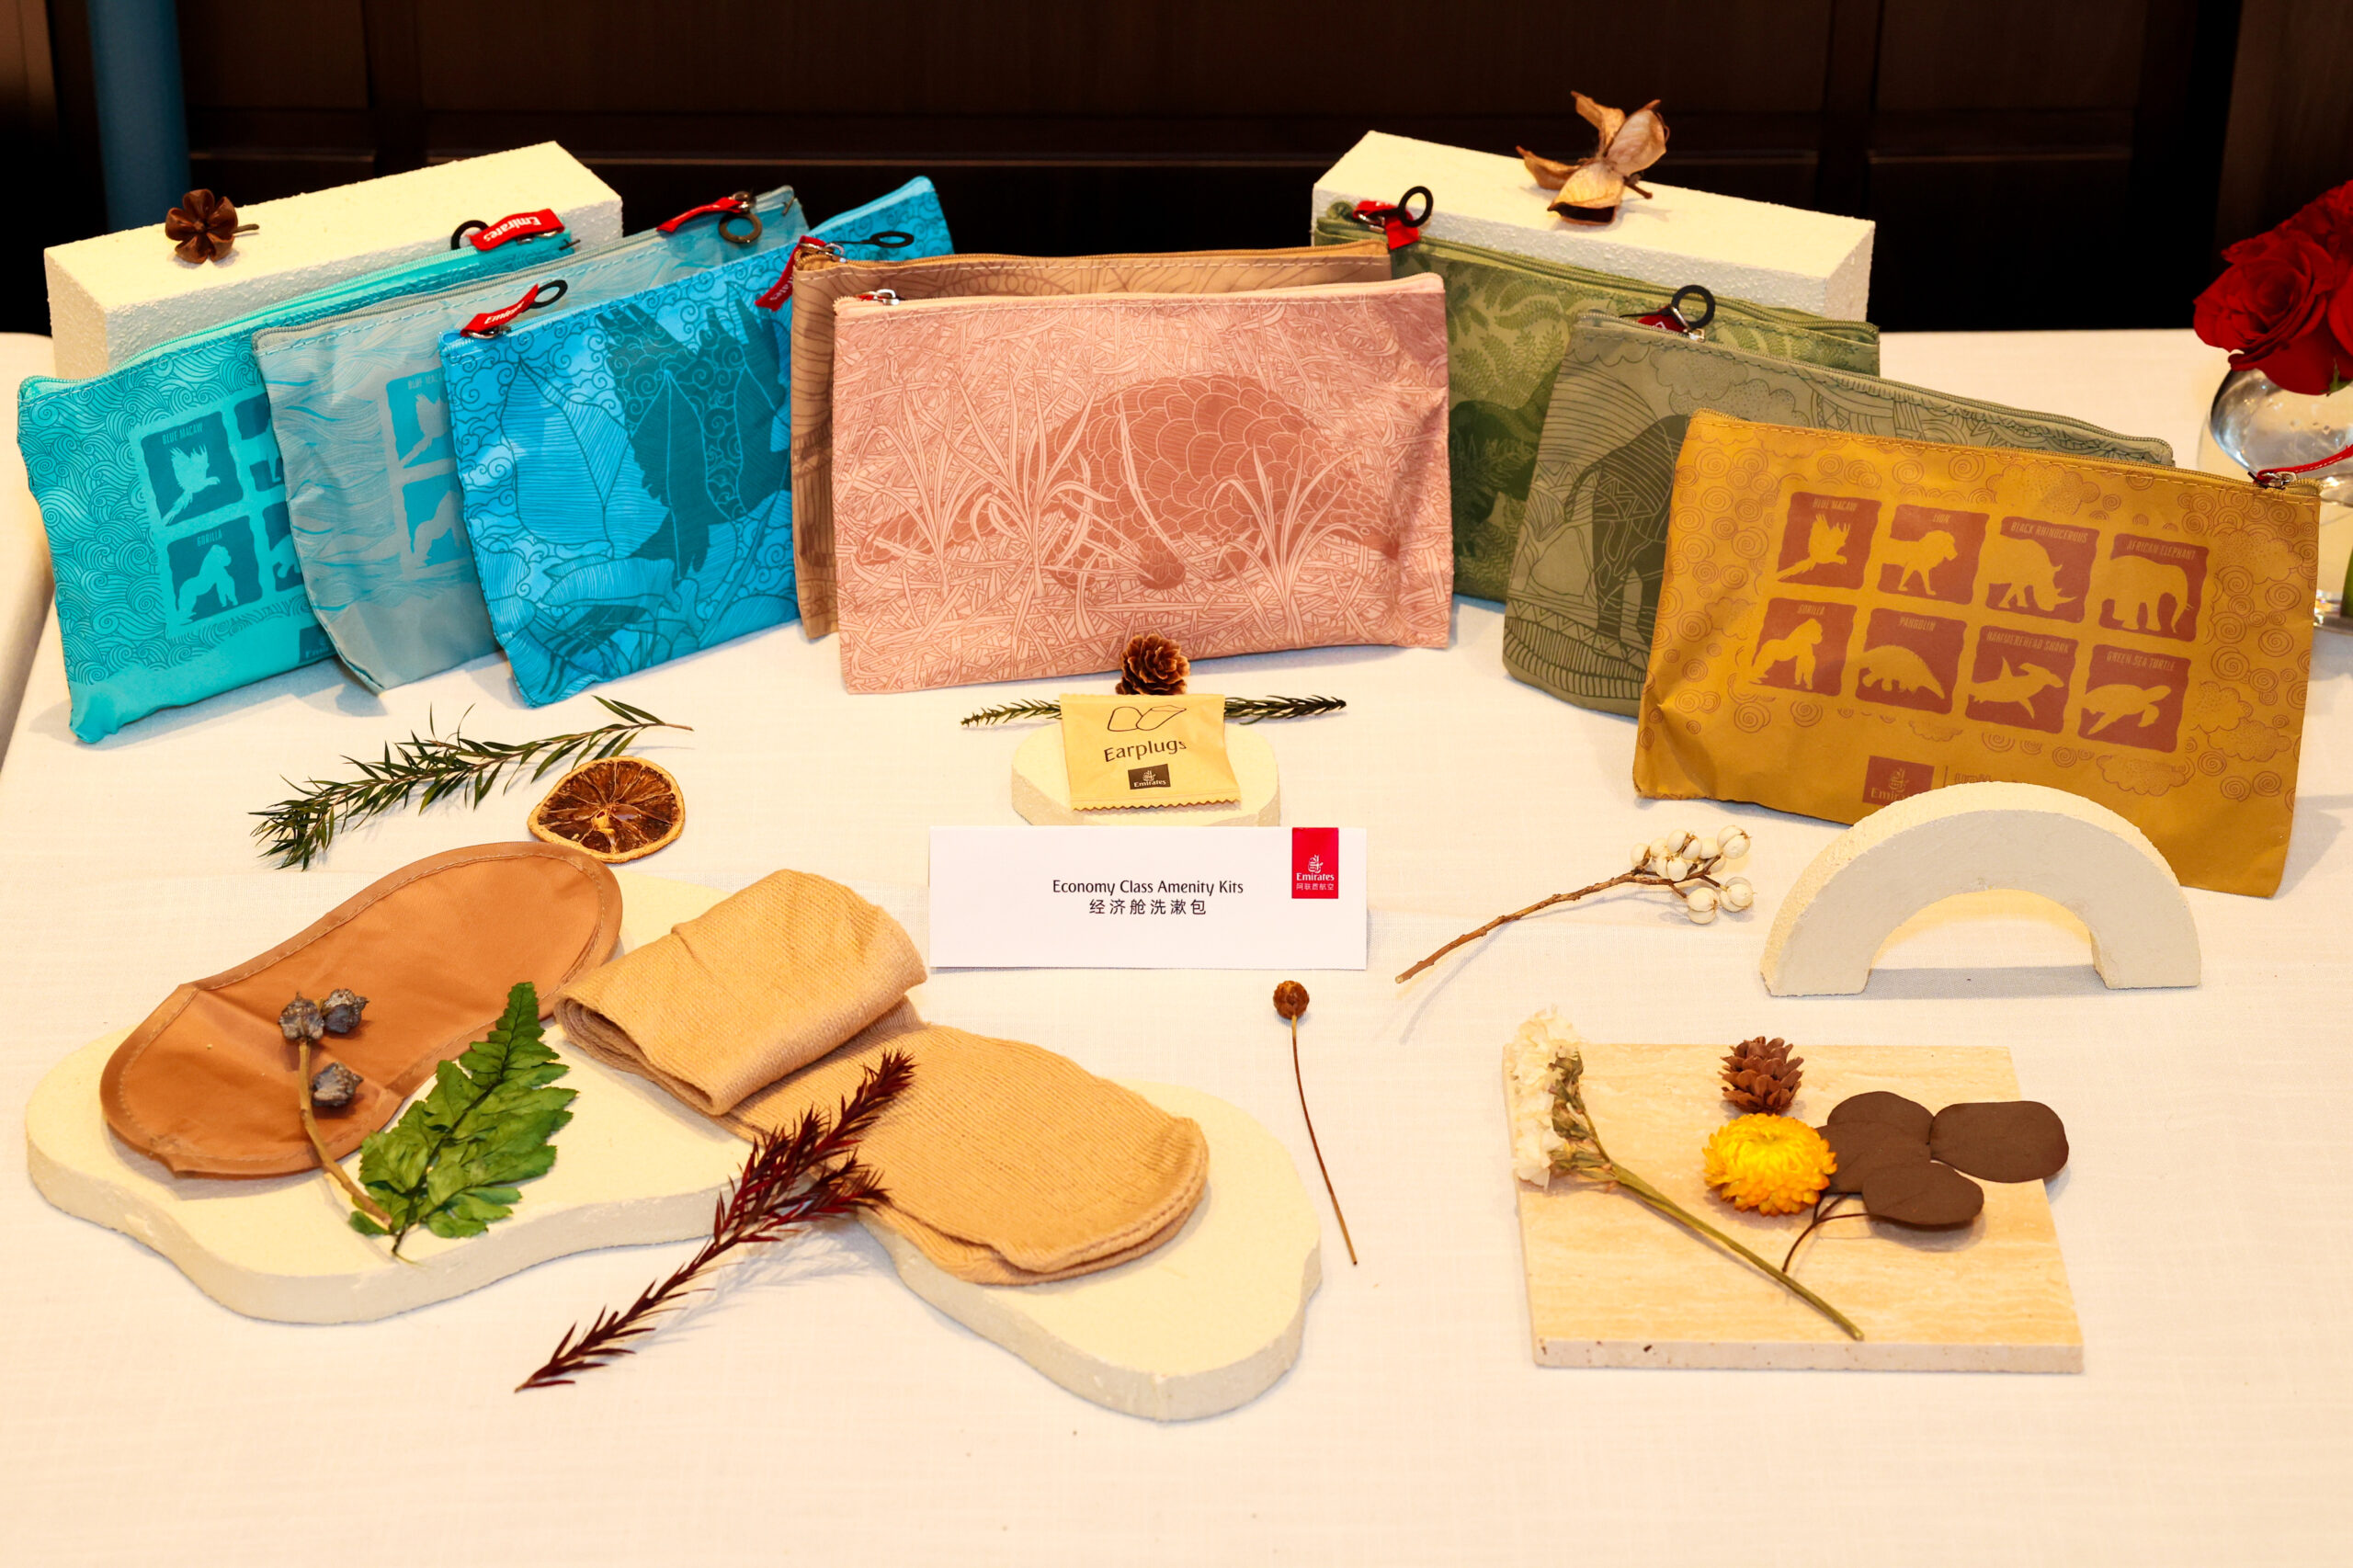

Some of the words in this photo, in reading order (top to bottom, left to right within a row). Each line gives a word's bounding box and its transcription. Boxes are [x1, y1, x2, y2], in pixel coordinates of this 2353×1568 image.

[483, 216, 542, 242] Emirates
[162, 432, 177, 445] BLUE
[179, 422, 204, 438] MACAW
[1813, 497, 1829, 509] BLUE
[1829, 499, 1858, 512] MACAW
[1932, 513, 1951, 524] LION
[2010, 521, 2034, 535] BLACK
[197, 528, 222, 547] GORILLA
[2126, 540, 2158, 554] AFRICAN
[2159, 543, 2197, 560] ELEPHANT
[1797, 603, 1826, 616] GORILLA
[1899, 616, 1937, 631] PANGOLIN
[2043, 640, 2069, 654] SHARK
[2106, 650, 2131, 665] GREEN
[2131, 653, 2148, 668] SEA
[2148, 655, 2177, 672] TURTLE
[1104, 740, 1187, 762] Earplugs
[1133, 779, 1166, 788] Emirates
[1296, 872, 1336, 881] Emirates
[1052, 880, 1115, 896] Economy
[1120, 880, 1154, 893] Class
[1157, 880, 1214, 896] Amenity
[1219, 880, 1244, 893] Kits
[1089, 899, 1207, 915] 经济舱洗漱包
